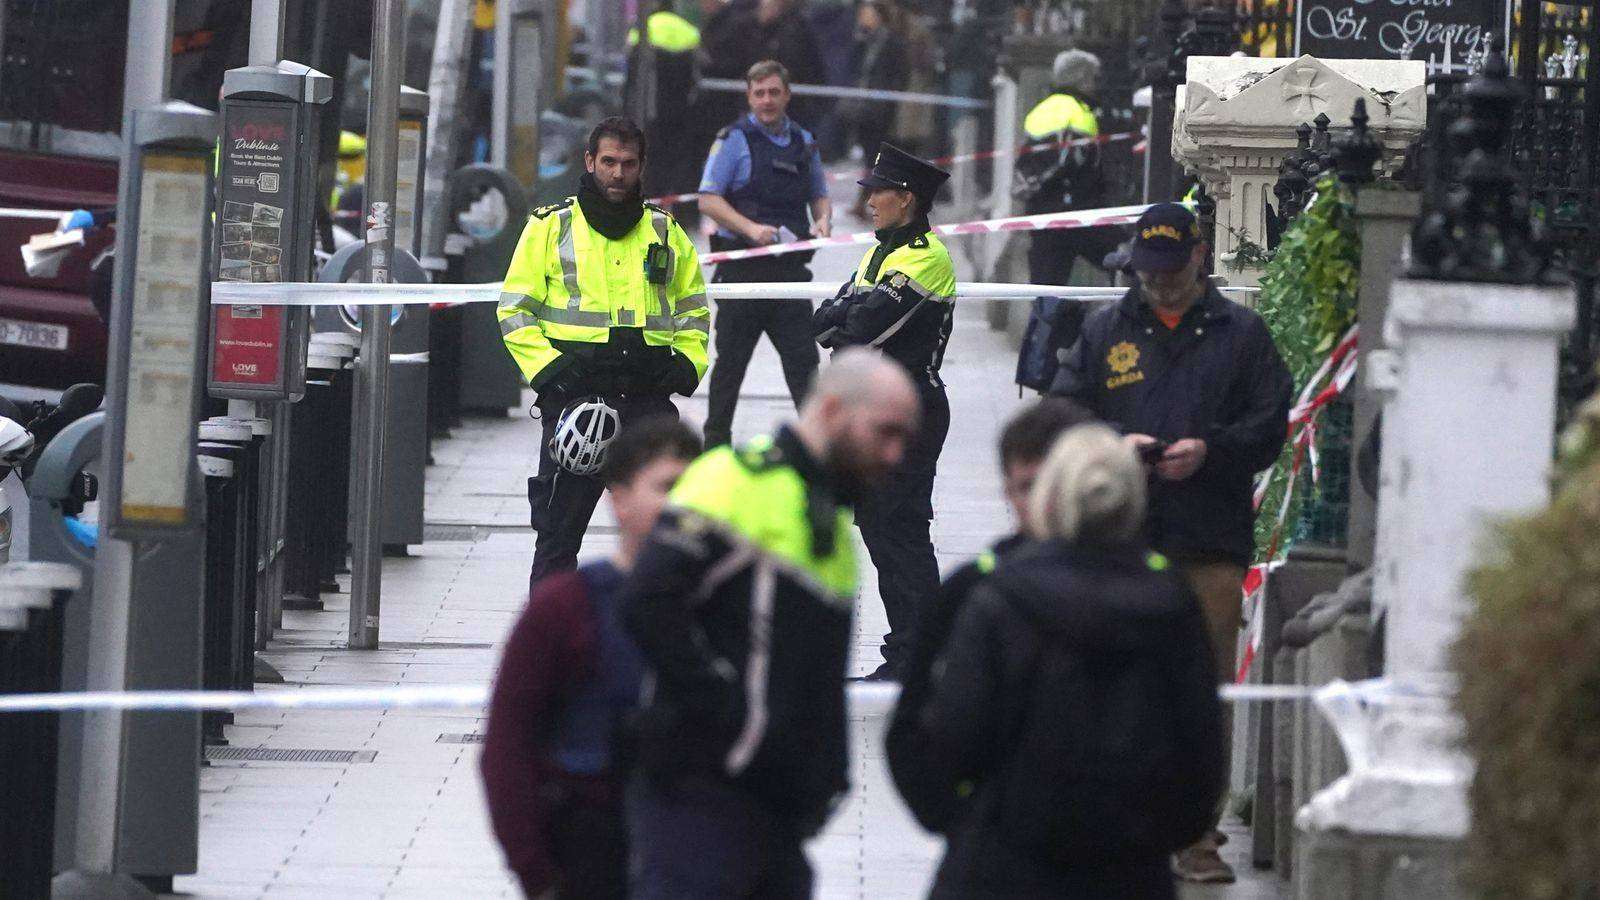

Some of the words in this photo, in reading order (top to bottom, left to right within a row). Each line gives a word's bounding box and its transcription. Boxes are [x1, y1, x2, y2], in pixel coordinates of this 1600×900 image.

[1379, 10, 1488, 58] Georg
[1142, 224, 1182, 241] GARDA
[878, 284, 902, 303] GARDA
[232, 363, 257, 372] LOVE
[1106, 370, 1144, 389] GARDA
